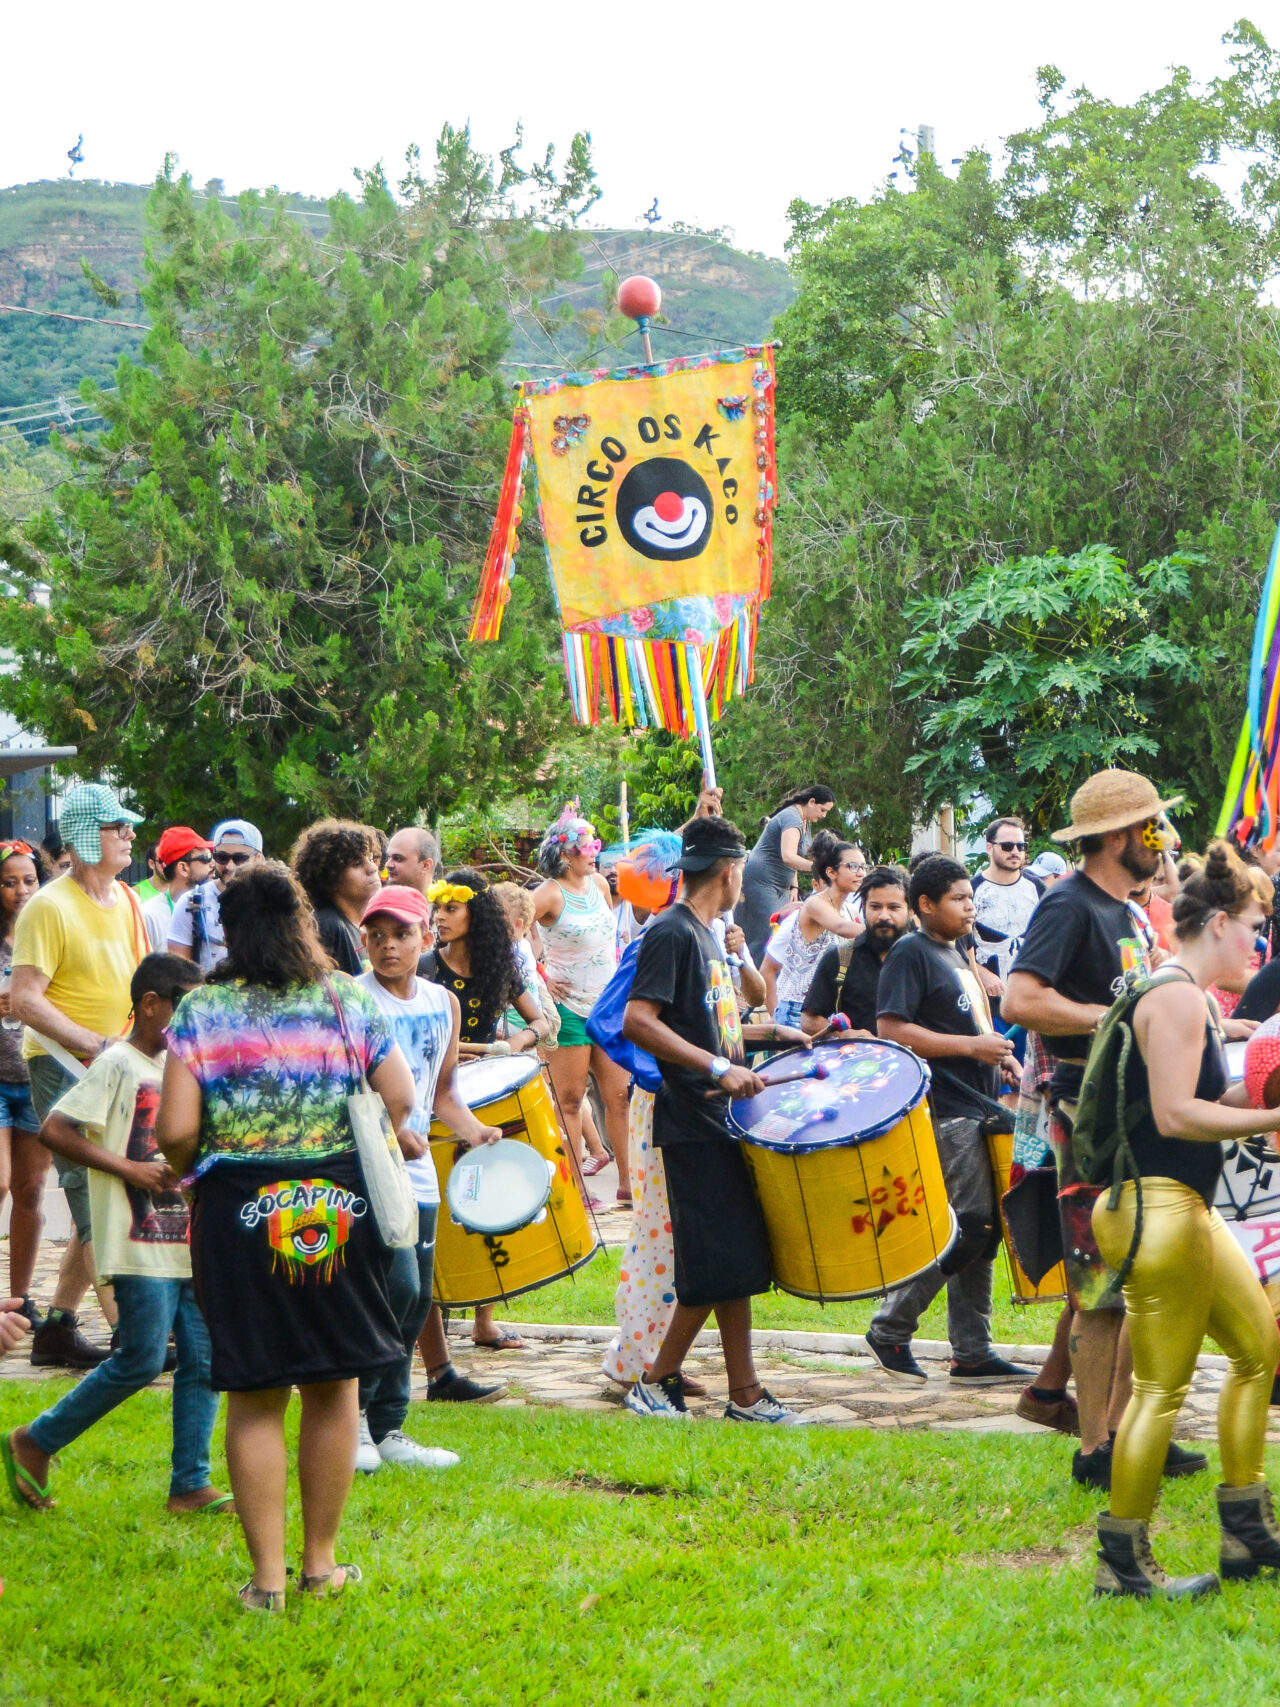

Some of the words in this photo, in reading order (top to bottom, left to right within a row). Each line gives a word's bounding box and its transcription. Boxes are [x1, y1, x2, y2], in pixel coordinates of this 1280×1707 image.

[576, 436, 627, 548] CIRCO
[637, 413, 682, 444] OS
[240, 1184, 368, 1228] SOCAPINO
[870, 1175, 908, 1205] OS
